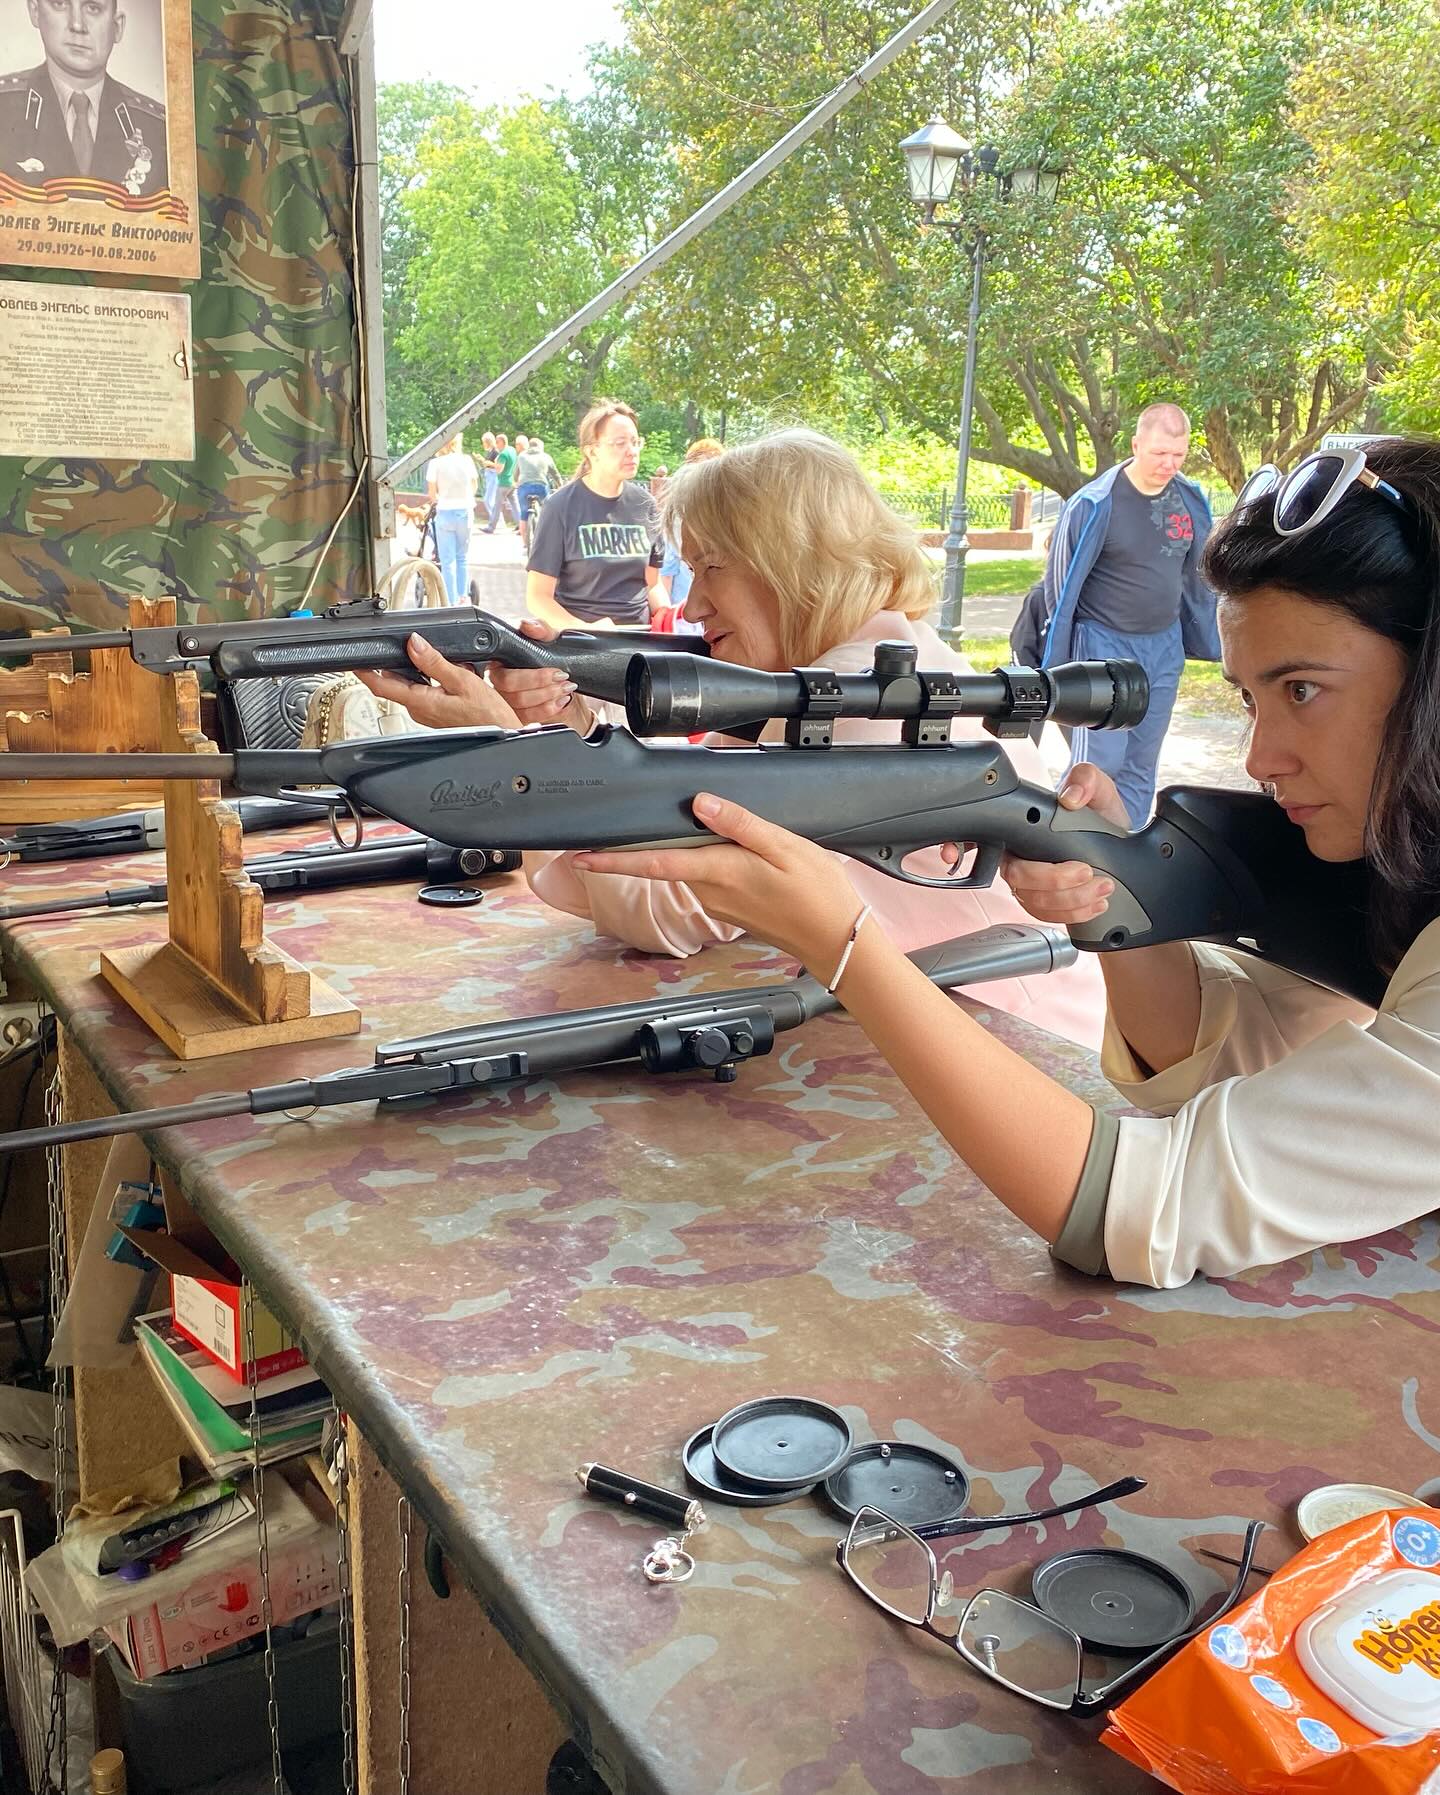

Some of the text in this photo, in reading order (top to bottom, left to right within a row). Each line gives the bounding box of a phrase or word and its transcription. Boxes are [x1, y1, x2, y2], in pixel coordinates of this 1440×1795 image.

[111, 222, 194, 244] ВИКТОРОВИЧ
[17, 239, 157, 262] 29.09.1926-10.08.2006
[41, 301, 90, 315] ЭНГЕЛЬС
[94, 305, 169, 321] ВИКТОРОВИЧ
[581, 526, 650, 556] MARVEL
